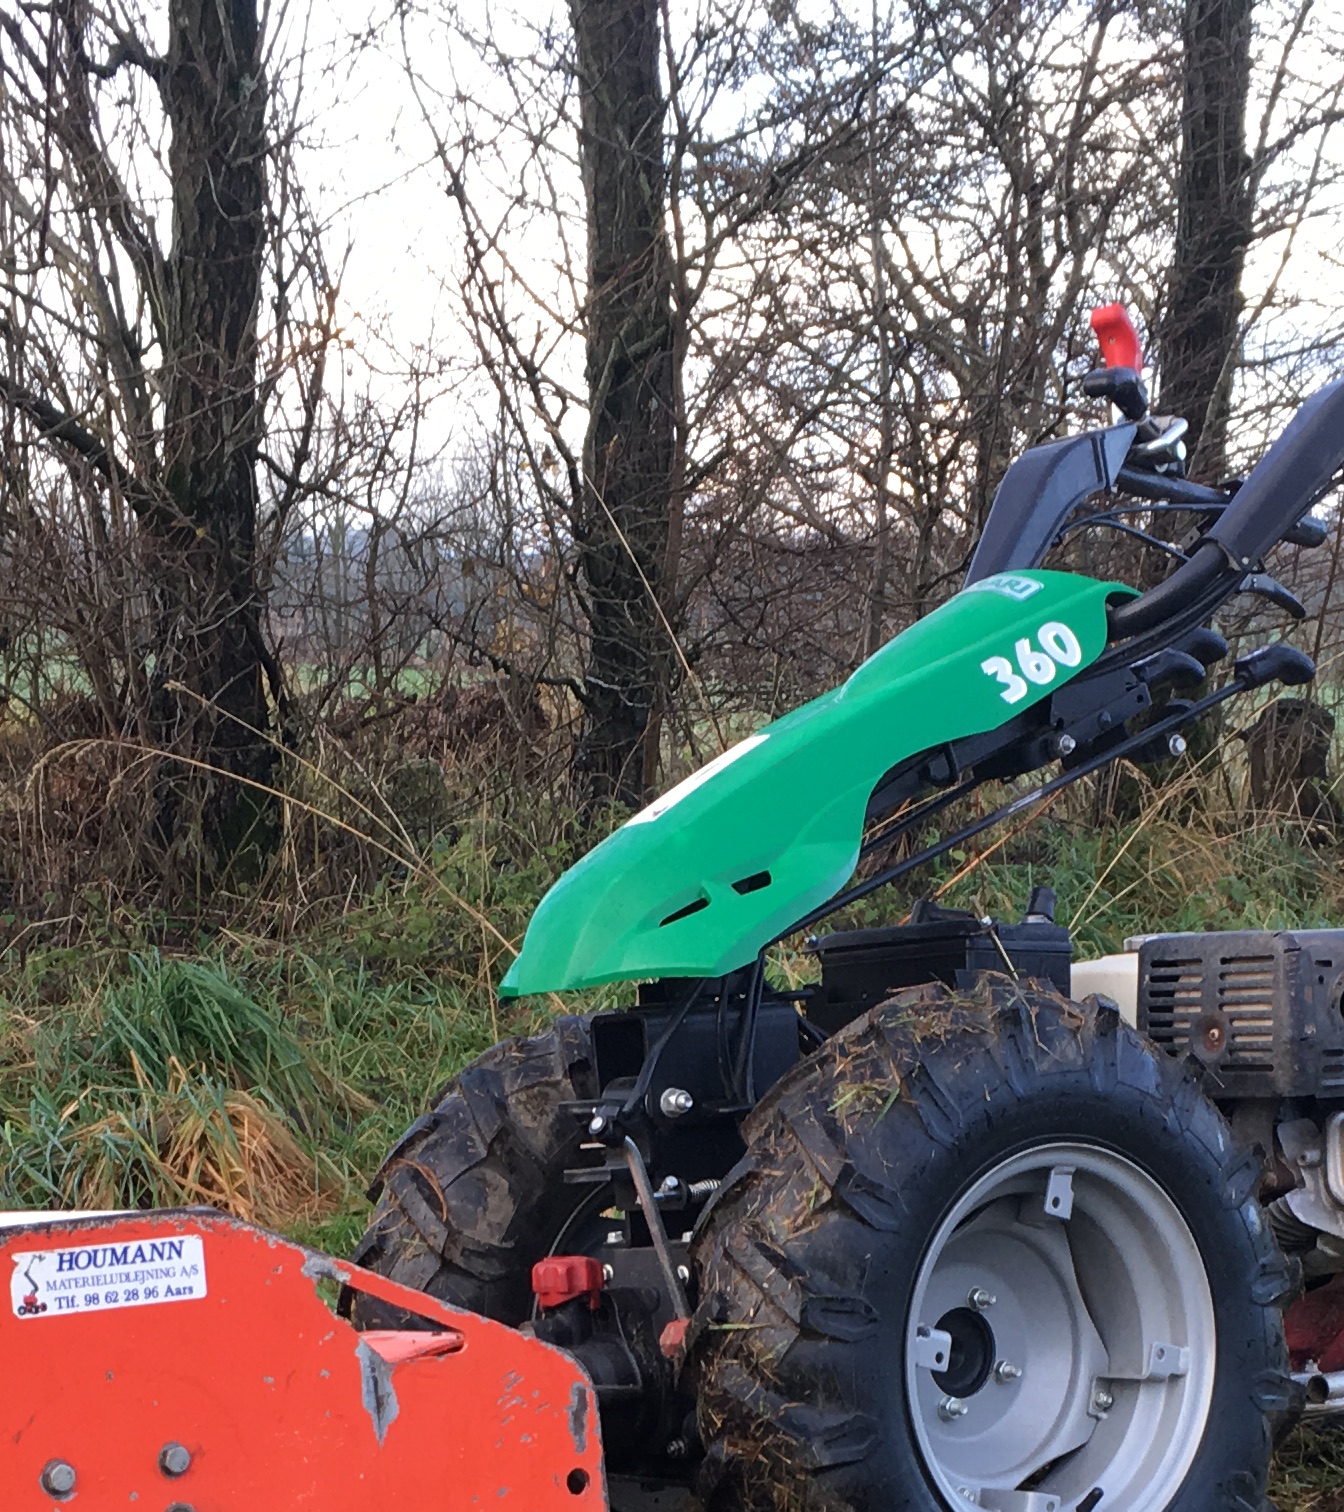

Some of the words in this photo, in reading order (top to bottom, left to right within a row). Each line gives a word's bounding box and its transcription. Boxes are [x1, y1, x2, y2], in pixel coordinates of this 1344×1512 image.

[980, 621, 1082, 704] 360
[56, 1239, 185, 1272] HOUMANN
[46, 1266, 176, 1292] MATERIELUDLEJNING
[180, 1264, 199, 1279] A/S
[54, 1296, 79, 1309] Tlf.
[84, 1292, 99, 1306] 98
[105, 1291, 119, 1304] 62
[124, 1288, 139, 1302] 28
[144, 1286, 159, 1299] 96
[164, 1284, 193, 1298] Aars
